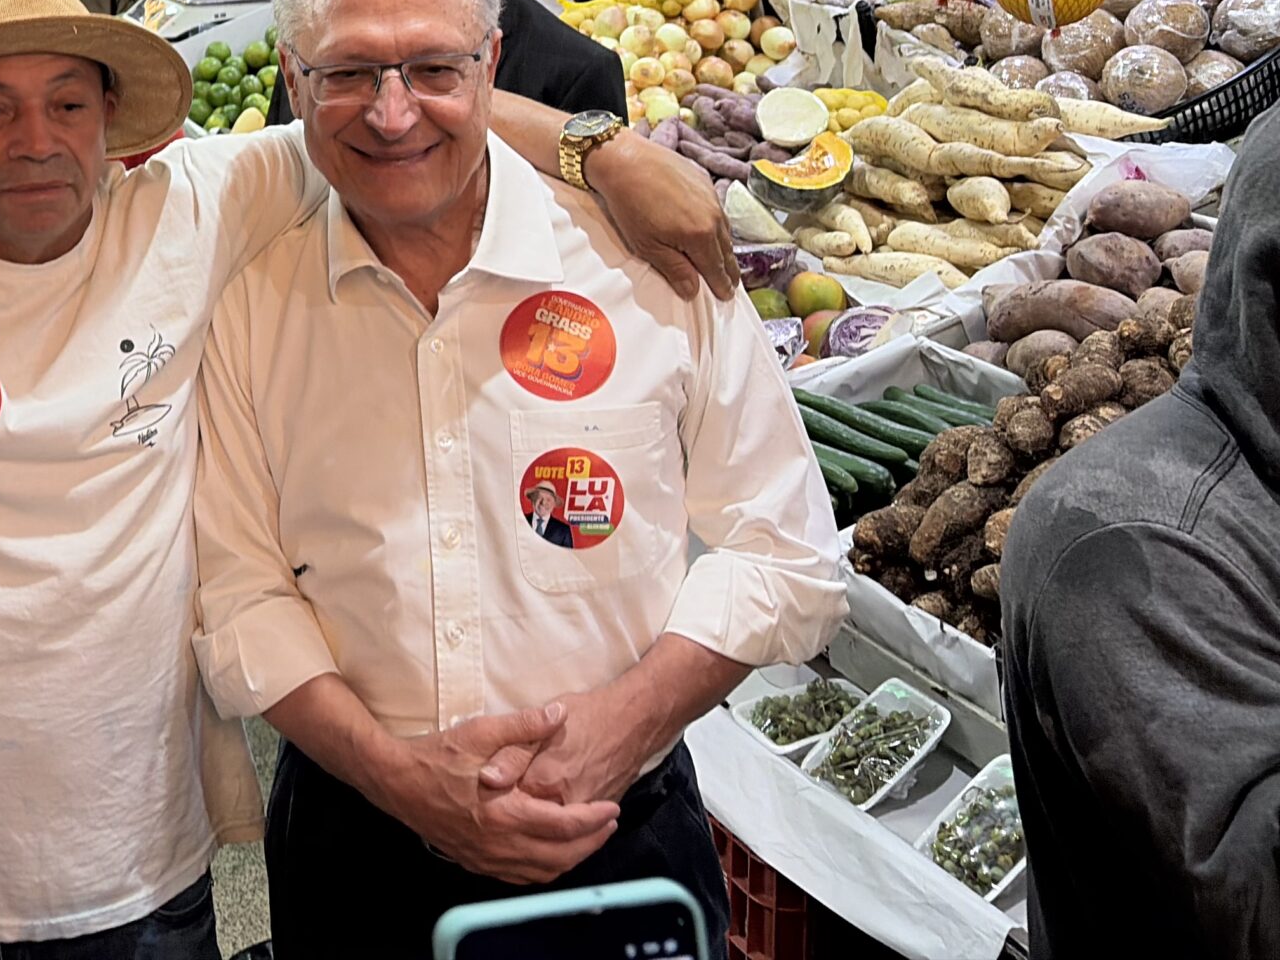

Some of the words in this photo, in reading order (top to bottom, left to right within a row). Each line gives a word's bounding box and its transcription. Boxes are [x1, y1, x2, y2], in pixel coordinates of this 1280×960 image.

[535, 308, 593, 340] GRASS
[540, 297, 600, 329] LEANDRO
[526, 323, 588, 374] 13
[534, 466, 565, 479] VOTE
[568, 459, 585, 474] 13
